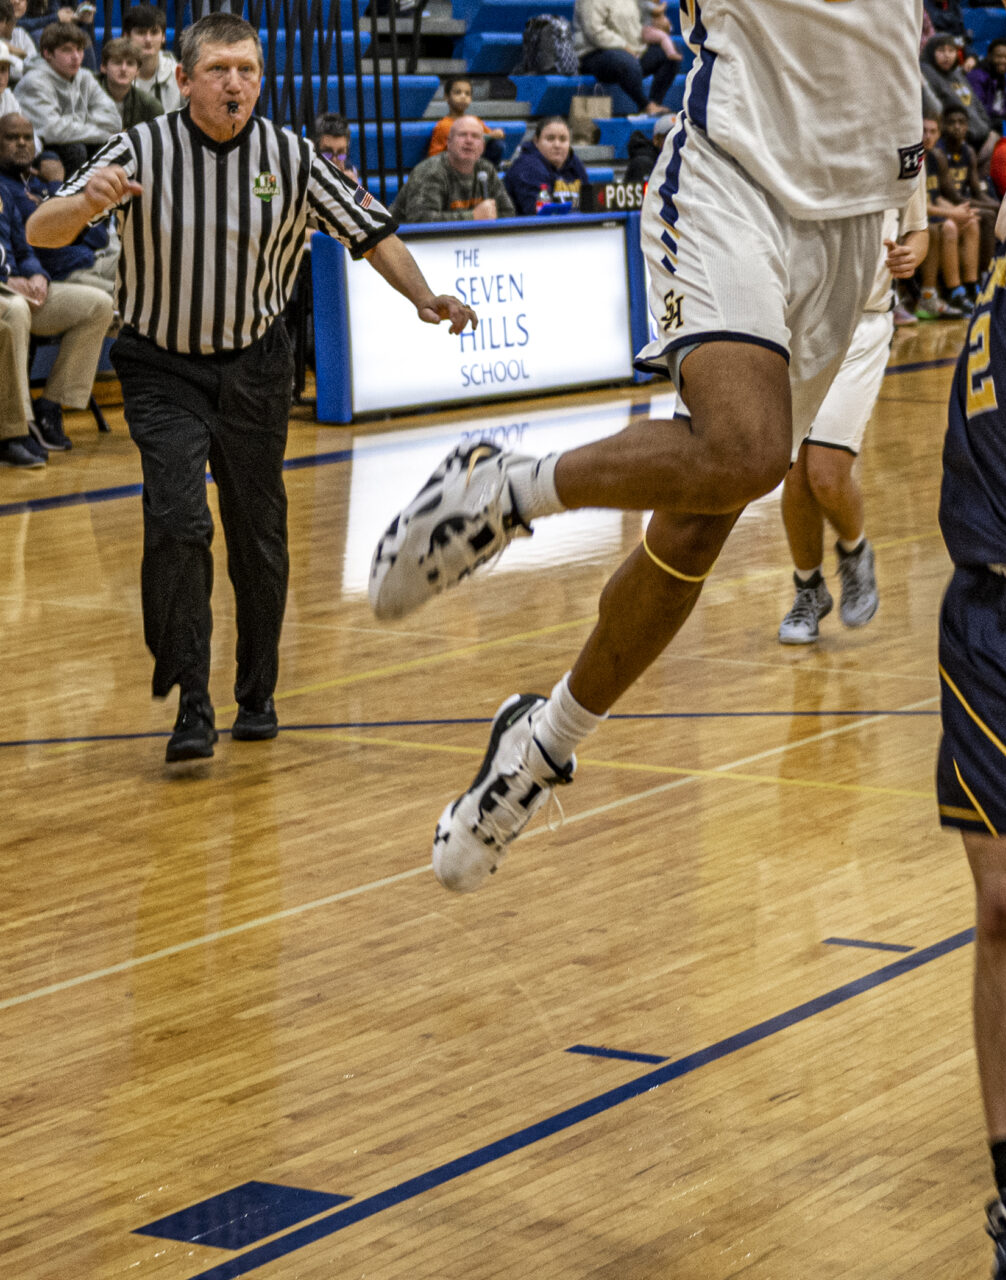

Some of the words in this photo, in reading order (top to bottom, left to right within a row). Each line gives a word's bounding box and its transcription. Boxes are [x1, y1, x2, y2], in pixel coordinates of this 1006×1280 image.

[605, 183, 643, 209] POSS
[455, 249, 481, 269] THE
[455, 273, 525, 305] SEVEN
[459, 314, 530, 353] HILLS
[461, 359, 531, 387] SCHOOL
[965, 310, 998, 420] 2
